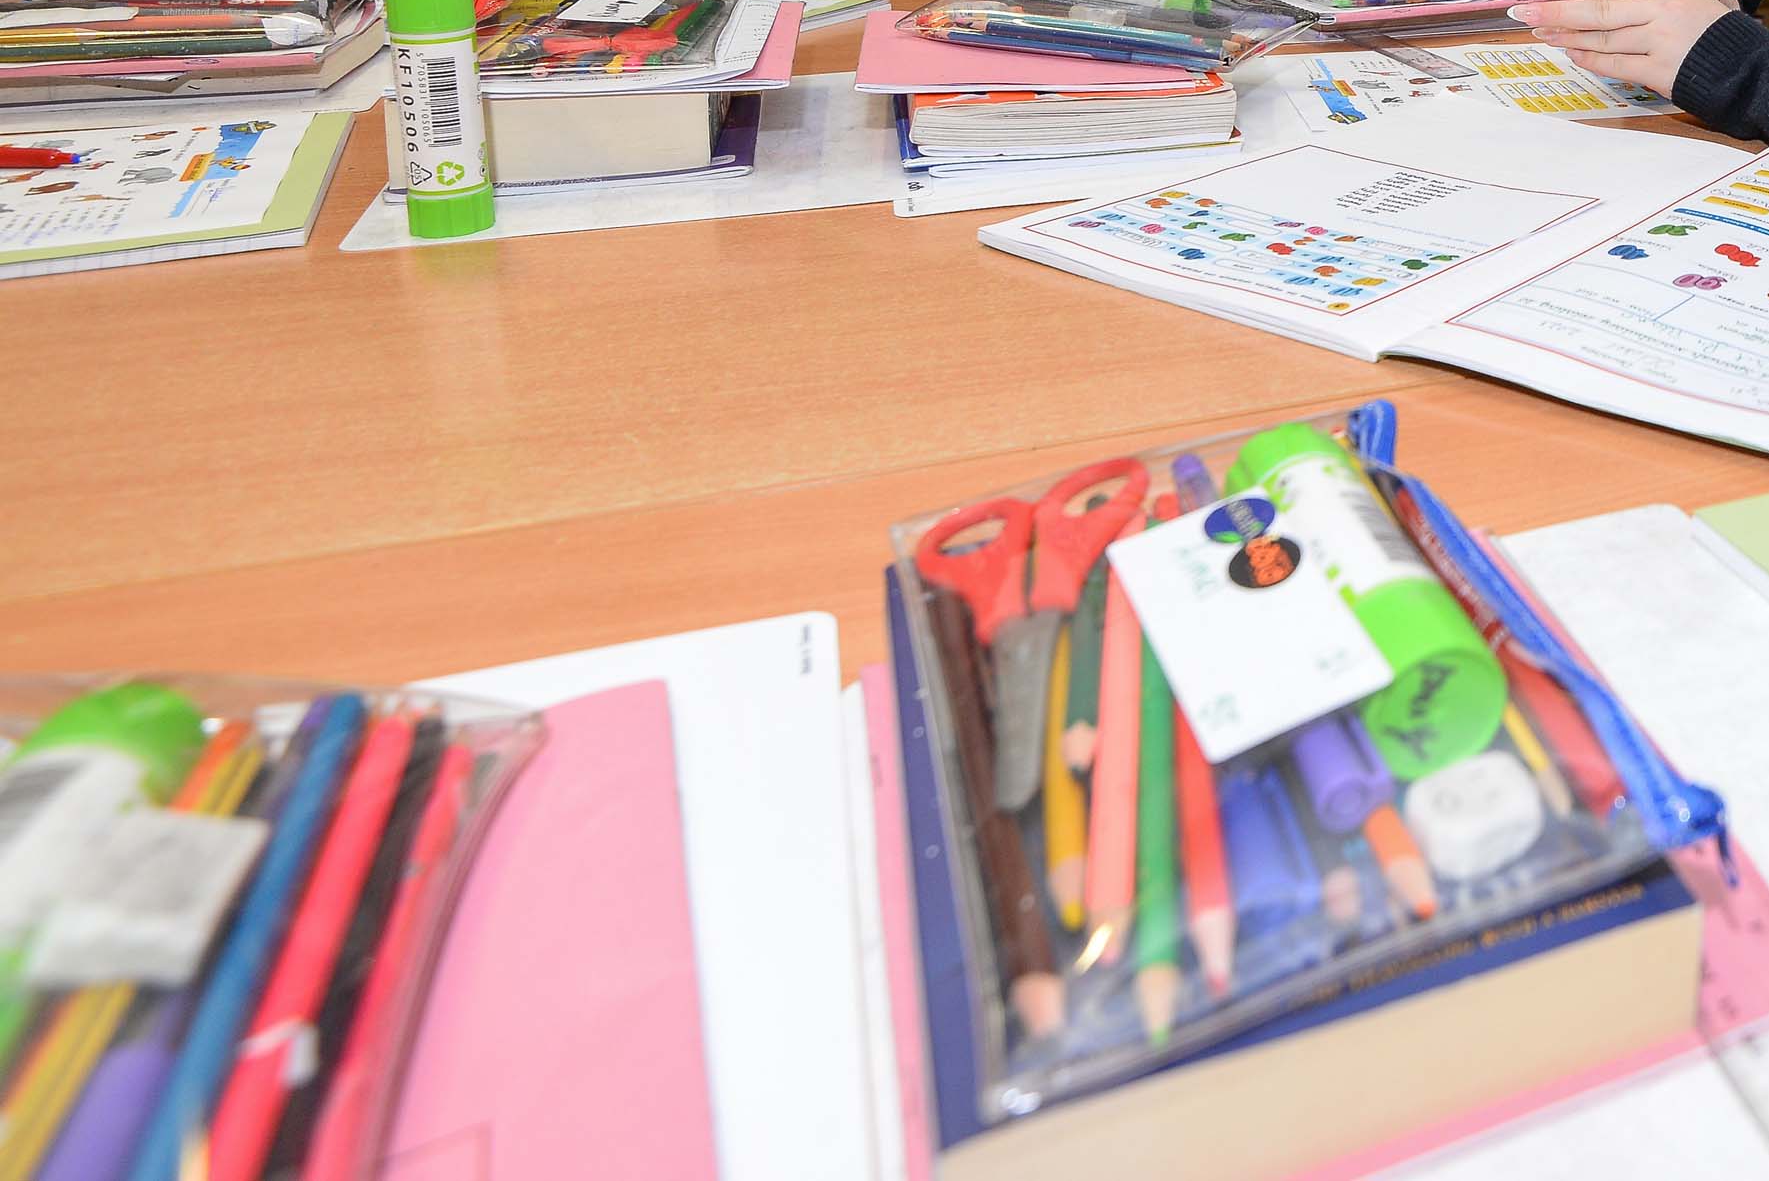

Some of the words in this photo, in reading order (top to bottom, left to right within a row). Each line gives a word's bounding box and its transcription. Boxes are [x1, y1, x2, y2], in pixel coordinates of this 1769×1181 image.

[396, 47, 419, 153] KF10506
[421, 108, 432, 144] 105065
[1672, 273, 1728, 291] 90
